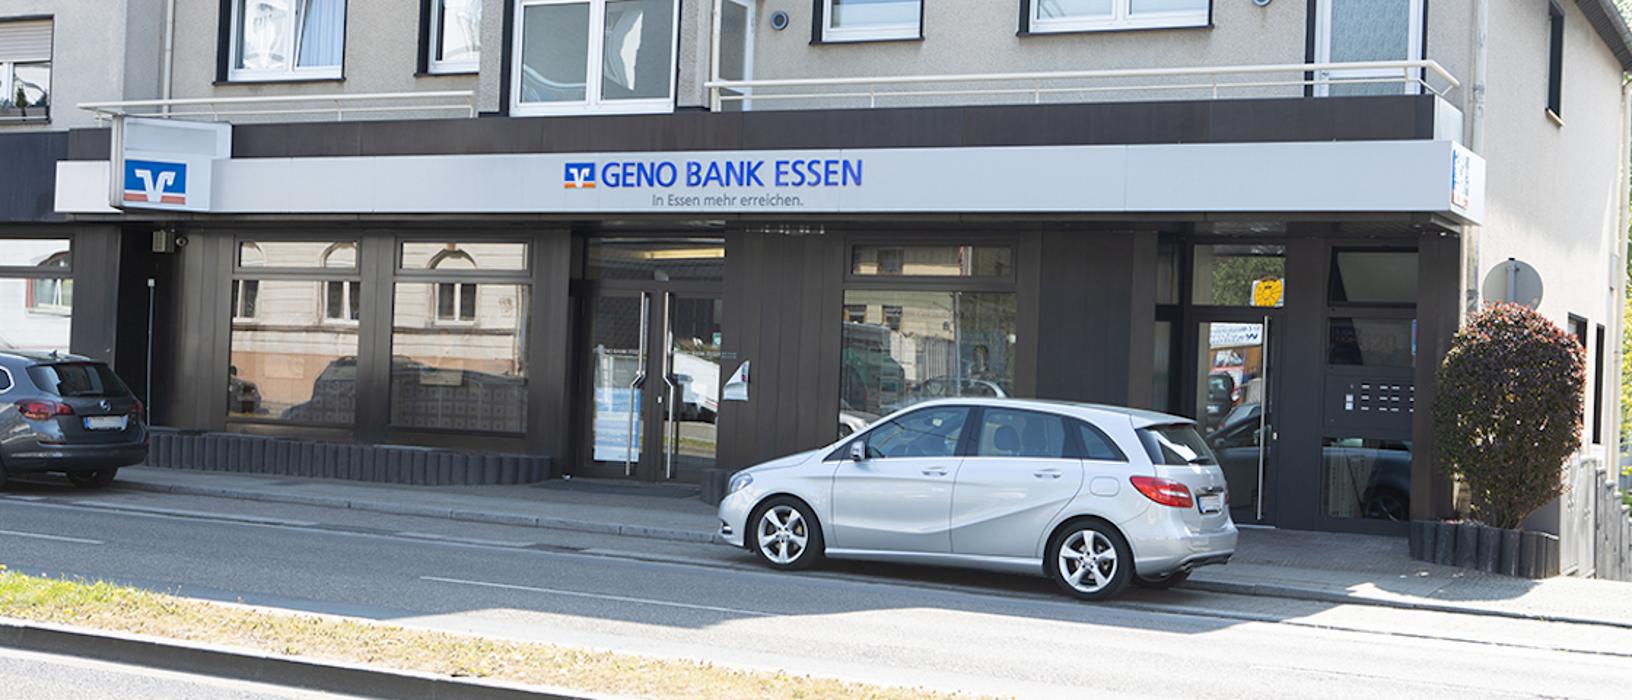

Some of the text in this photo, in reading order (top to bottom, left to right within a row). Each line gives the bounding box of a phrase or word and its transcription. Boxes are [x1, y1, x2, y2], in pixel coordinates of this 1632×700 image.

[601, 159, 863, 188] GENO BANK ESSEN
[652, 192, 804, 206] In Essen mehr erreichen.
